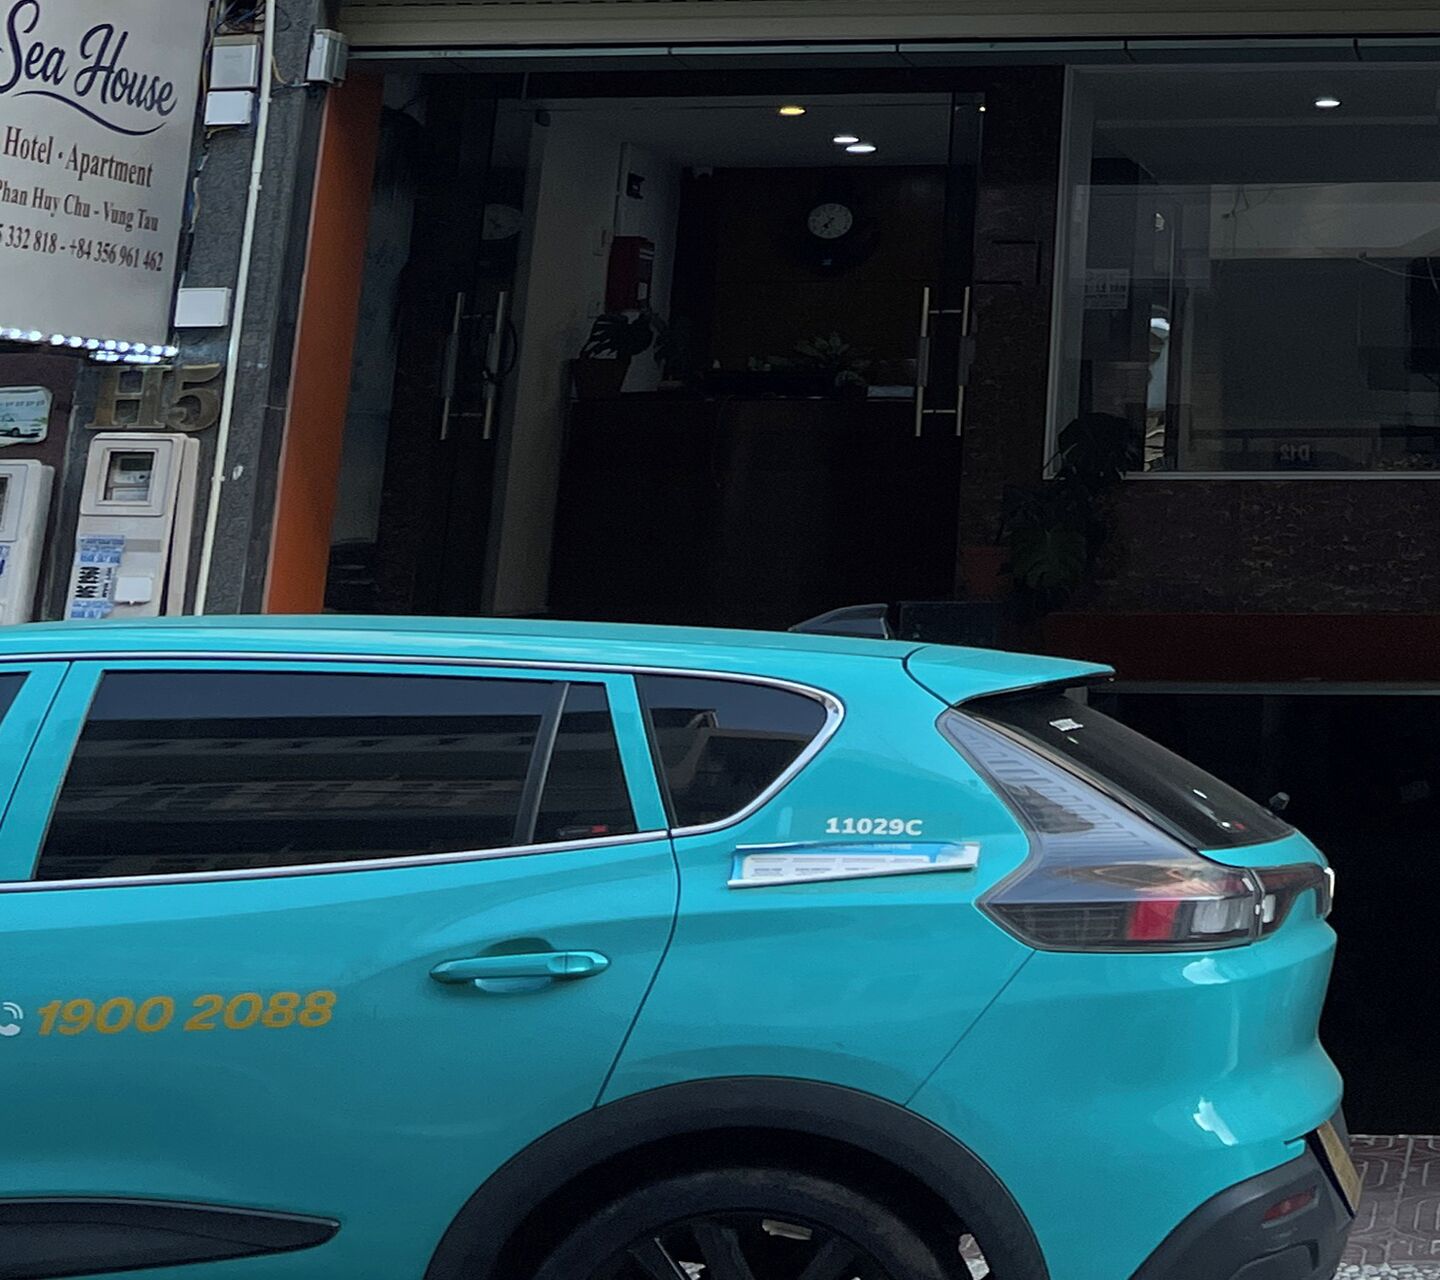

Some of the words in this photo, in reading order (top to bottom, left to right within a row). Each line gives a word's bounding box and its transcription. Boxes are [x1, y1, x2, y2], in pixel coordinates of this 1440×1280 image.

[74, 23, 177, 116] House
[2, 125, 54, 165] Hotel
[65, 143, 154, 188] Apartment
[32, 186, 60, 218] Huy
[64, 193, 91, 218] Chu
[104, 200, 135, 232] Vung
[137, 209, 160, 232] Tau
[5, 225, 30, 249] 332
[33, 230, 58, 254] 818
[69, 238, 92, 260] +84
[94, 241, 117, 265] 356
[119, 246, 141, 269] 961
[143, 251, 164, 272] 462
[85, 363, 222, 431] H5
[825, 817, 923, 836] 11029C
[37, 996, 175, 1036] 1900
[183, 990, 337, 1032] 2088
